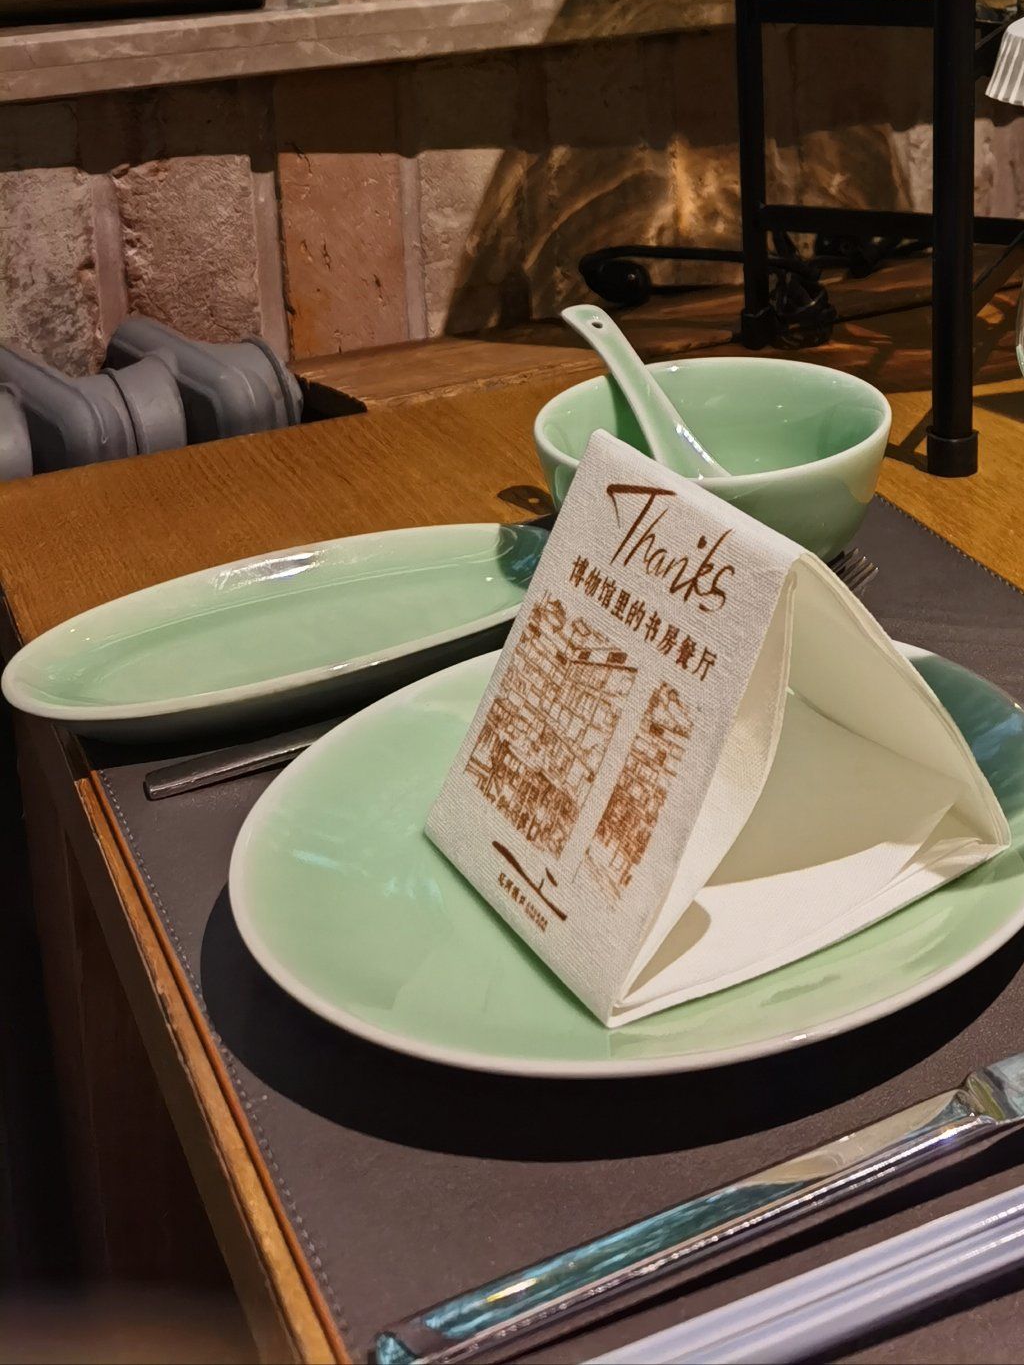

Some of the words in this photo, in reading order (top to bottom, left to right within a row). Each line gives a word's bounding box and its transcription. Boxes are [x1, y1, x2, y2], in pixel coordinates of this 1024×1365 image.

[606, 484, 736, 614] Thanks
[570, 554, 719, 682] 博物馆里的书房餐厅
